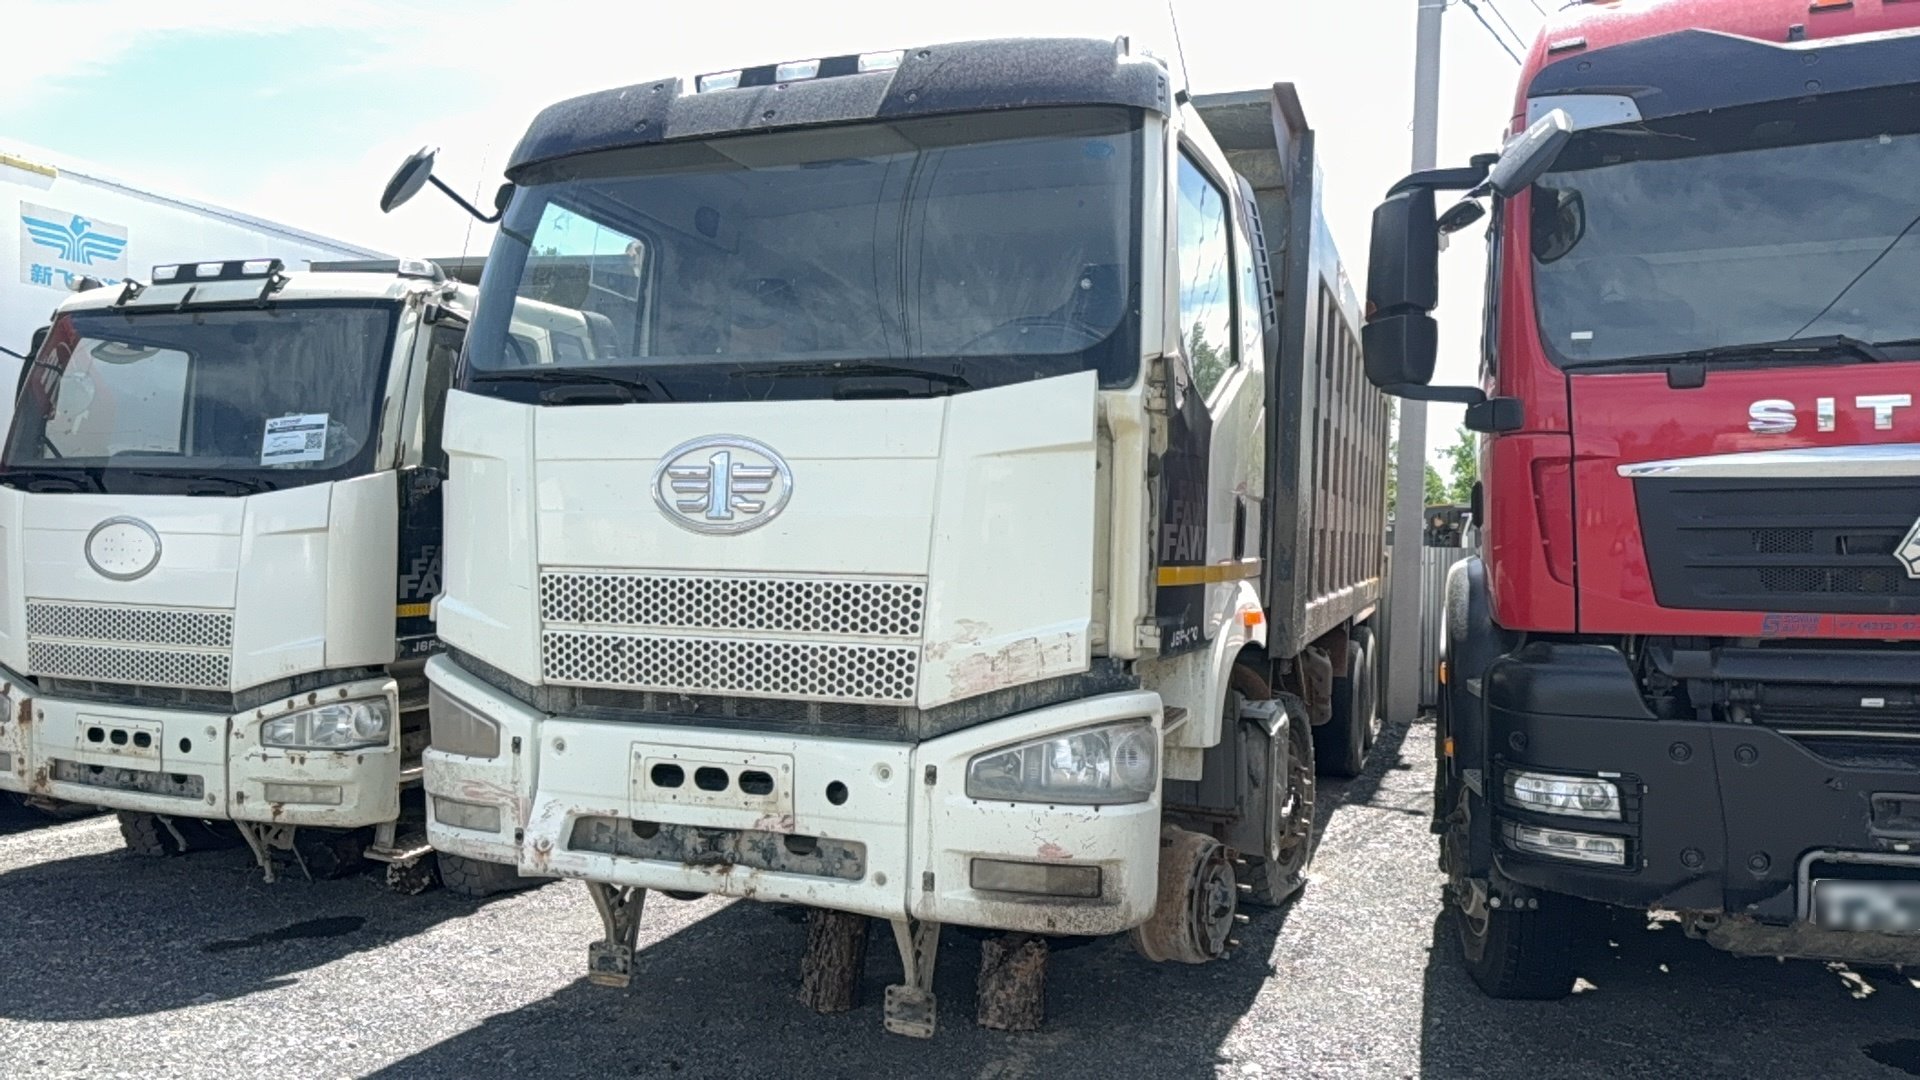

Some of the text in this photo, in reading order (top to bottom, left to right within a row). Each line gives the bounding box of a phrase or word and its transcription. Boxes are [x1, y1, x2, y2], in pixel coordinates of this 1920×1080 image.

[30, 263, 121, 291] 新飞
[1747, 394, 1912, 434] SIT
[1161, 524, 1205, 561] FAW
